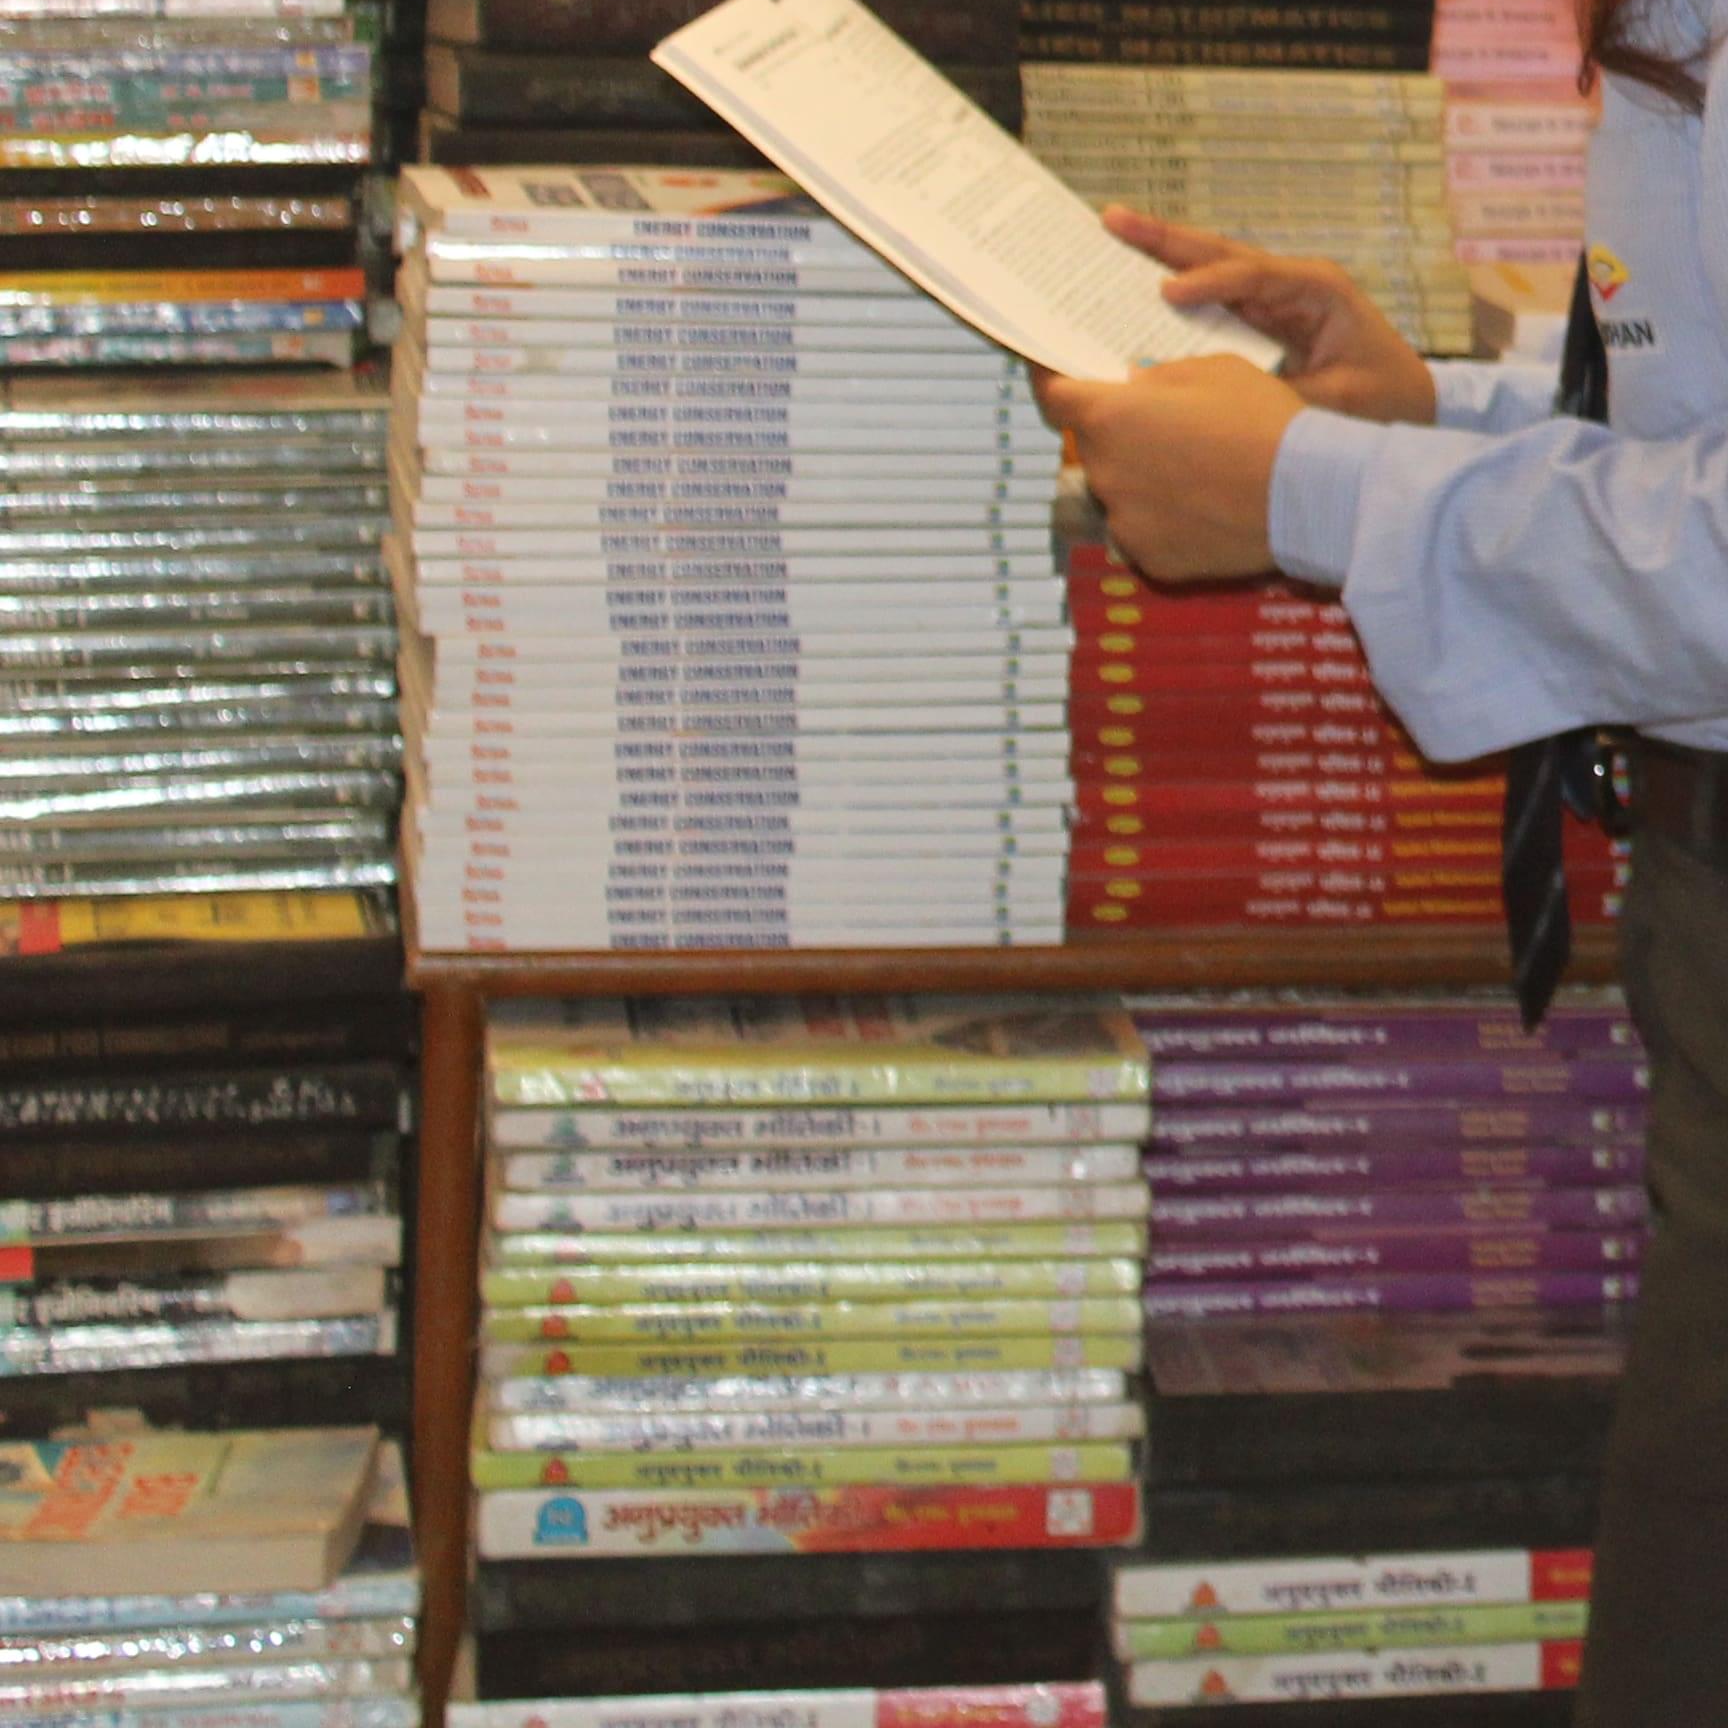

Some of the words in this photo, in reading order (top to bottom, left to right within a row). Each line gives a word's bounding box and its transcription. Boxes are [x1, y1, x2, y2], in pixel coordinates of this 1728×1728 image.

[633, 221, 690, 237] ENERGY
[696, 223, 810, 240] CONSERVATION
[620, 269, 677, 283] ENERGY
[683, 270, 798, 286] CONSERVATION
[616, 299, 675, 315] ENERGY
[681, 301, 796, 319] CONSERVATION
[614, 326, 673, 345] ENERGY
[679, 328, 794, 346] CONSERVATION
[611, 378, 670, 395] ENERGY
[676, 380, 792, 398] CONSERVATION
[608, 405, 668, 421] ENERGY
[674, 405, 788, 423] CONSERVATION
[608, 429, 668, 446] ENERGY
[674, 430, 789, 448] CONSERVATION
[612, 456, 672, 473] ENERGY
[678, 457, 793, 475] CONSERVATION
[607, 481, 666, 498] ENERGY
[672, 482, 787, 499] CONSERVATION
[607, 561, 667, 579] ENERGY
[673, 561, 788, 580] CONSERVATION
[605, 588, 666, 606] ENERGY
[672, 588, 787, 605] CONSERVATION
[609, 611, 669, 629] ENERGY
[675, 611, 790, 629] CONSERVATION
[621, 638, 680, 655] ENERGY
[686, 637, 800, 655] CONSERVATION
[618, 664, 678, 681] ENERGY
[684, 663, 799, 680] CONSERVATION
[615, 686, 674, 705] ENERGY
[680, 686, 795, 704] CONSERVATION
[617, 714, 677, 729] ENERGY
[683, 713, 798, 730] CONSERVATION
[614, 742, 674, 757] ENERGY
[680, 741, 795, 758] CONSERVATION
[616, 766, 676, 781] ENERGY
[682, 765, 797, 782] CONSERVATION
[619, 790, 680, 807] ENERGY
[686, 789, 800, 807] CONSERVATION
[608, 813, 668, 830] ENERGY
[674, 814, 790, 832] CONSERVATION
[614, 839, 674, 855] ENERGY
[680, 839, 795, 855] CONSERVATION
[605, 884, 665, 900] ENERGY
[671, 884, 786, 901] CONSERVATION
[607, 907, 667, 924] ENERGY
[673, 907, 788, 924] CONSERVATION
[608, 932, 669, 949] ENERGY
[675, 931, 791, 949] CONSERVATION
[602, 1502, 748, 1547] अनुप्रयुक्त
